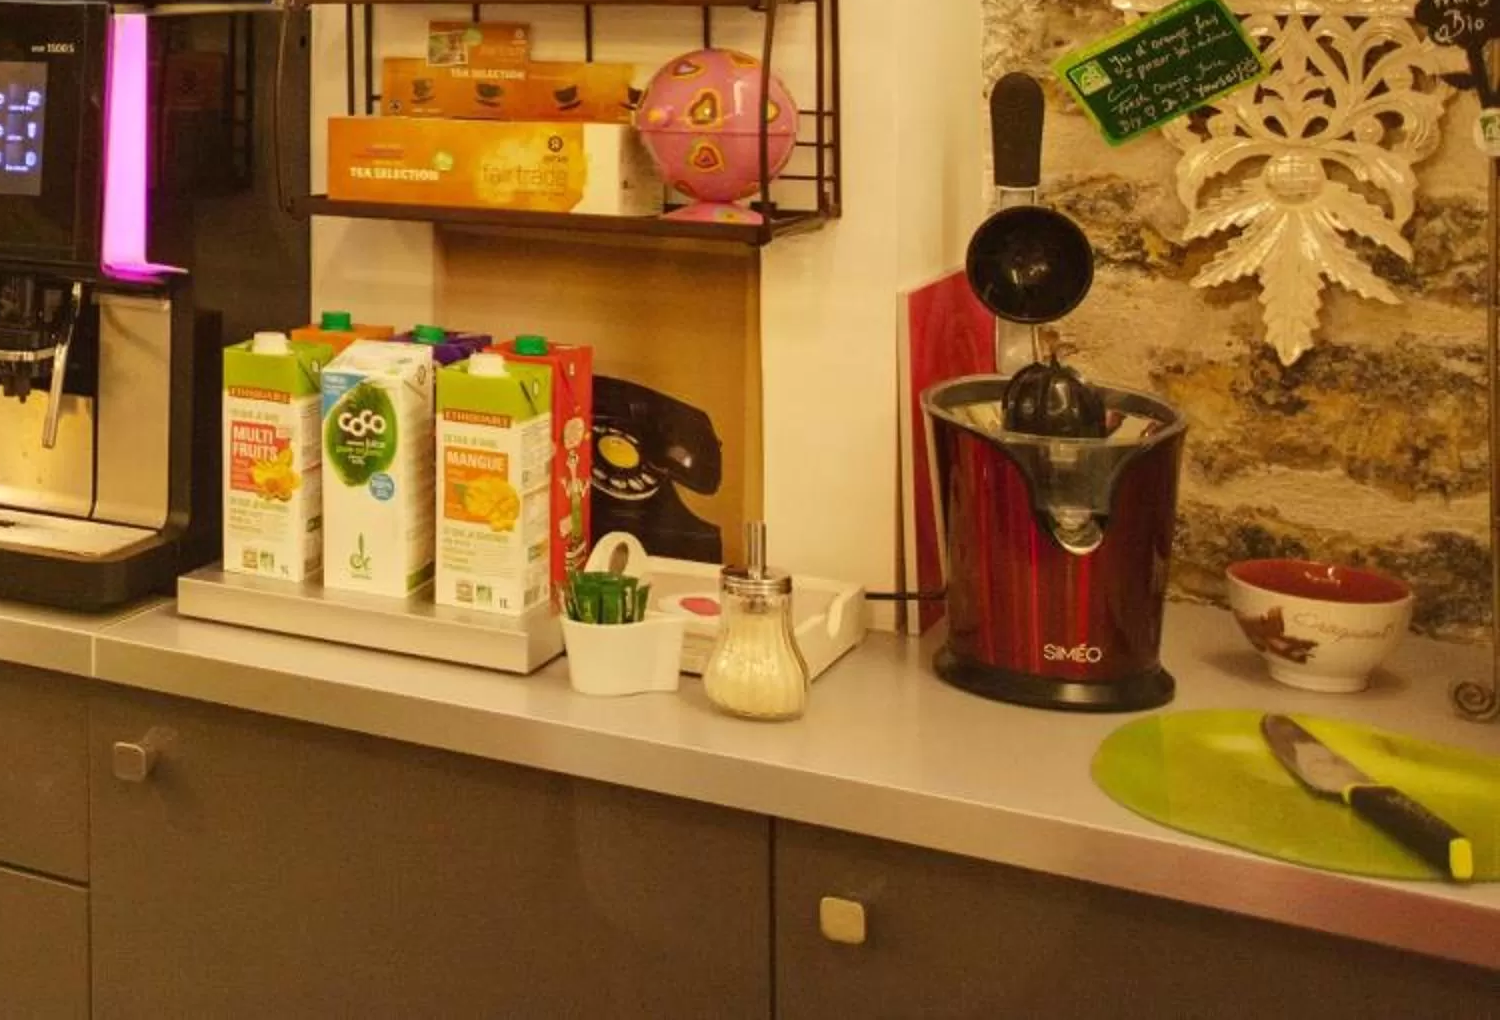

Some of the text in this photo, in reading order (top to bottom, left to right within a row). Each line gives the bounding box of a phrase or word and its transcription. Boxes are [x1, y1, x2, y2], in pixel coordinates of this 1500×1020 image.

[233, 426, 273, 445] MULTI
[233, 442, 278, 462] FRUITS
[447, 451, 504, 472] MANGUE
[1043, 643, 1103, 664] SIMÉO
